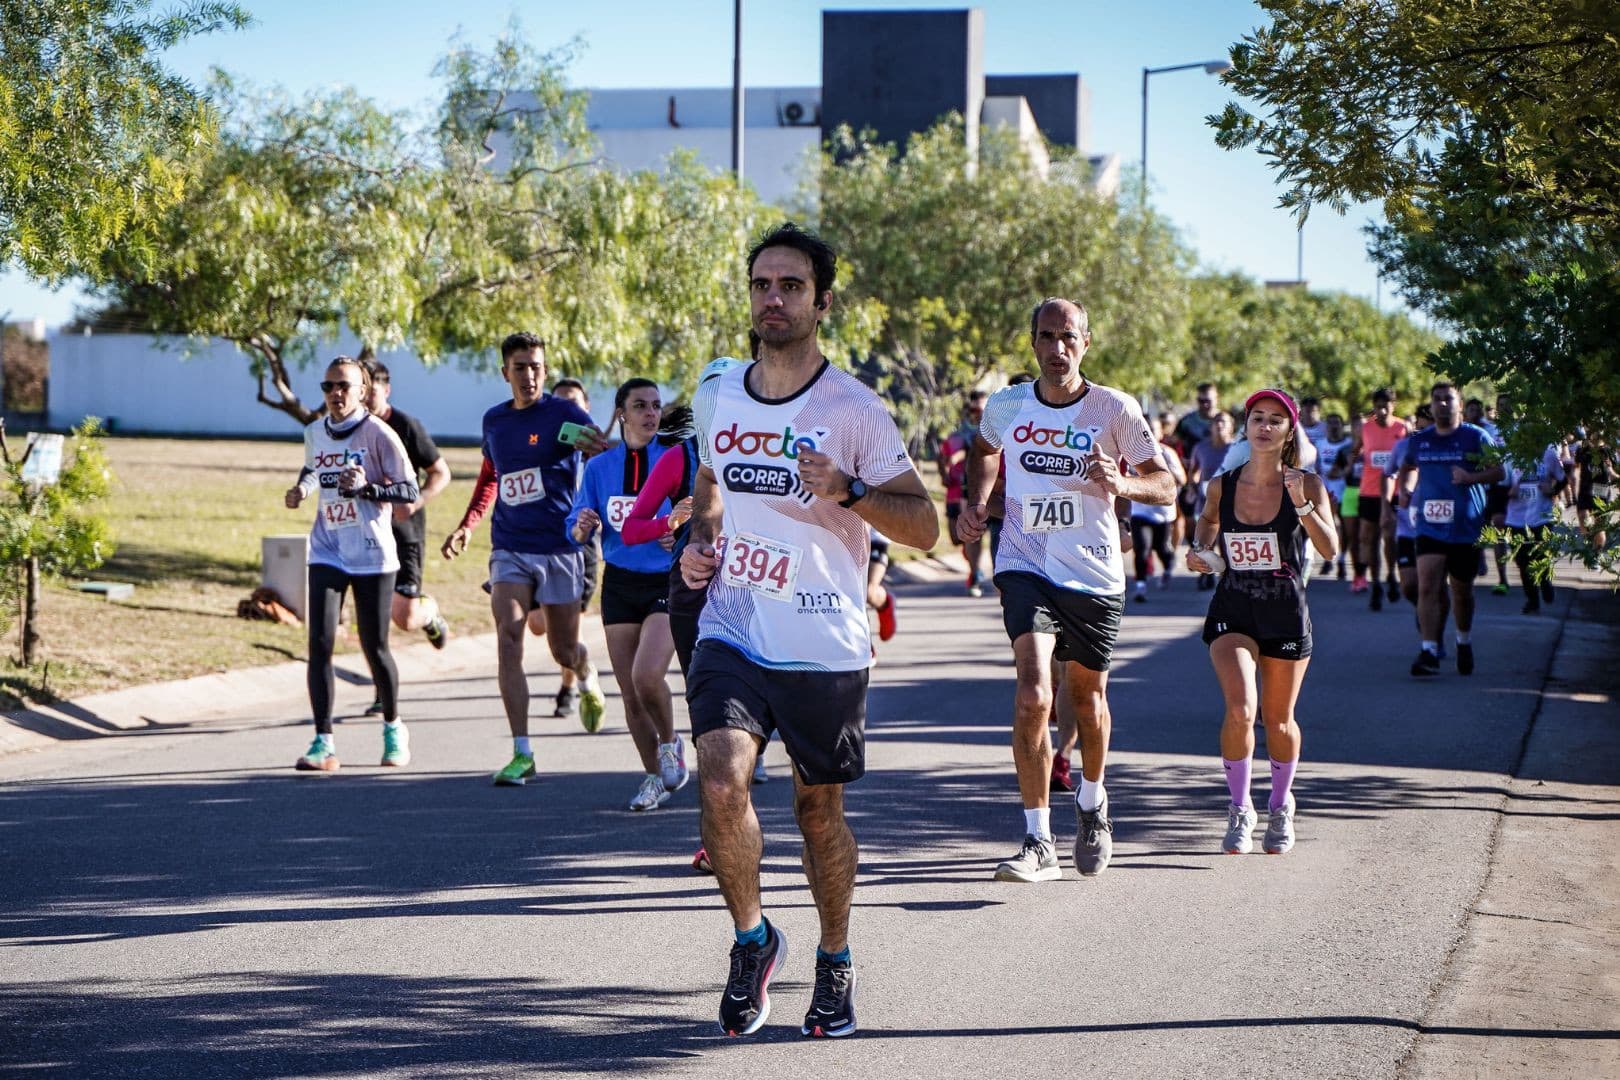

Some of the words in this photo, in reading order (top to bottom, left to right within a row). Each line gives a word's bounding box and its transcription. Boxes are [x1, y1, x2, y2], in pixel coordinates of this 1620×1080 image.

[1013, 421, 1092, 451] docta
[1025, 454, 1071, 470] CORRE
[504, 473, 538, 498] 312
[728, 466, 789, 487] CORRE
[327, 502, 357, 522] 424
[1030, 501, 1074, 527] 740
[1426, 502, 1452, 517] 326
[1230, 541, 1274, 563] 354
[728, 542, 790, 589] 394
